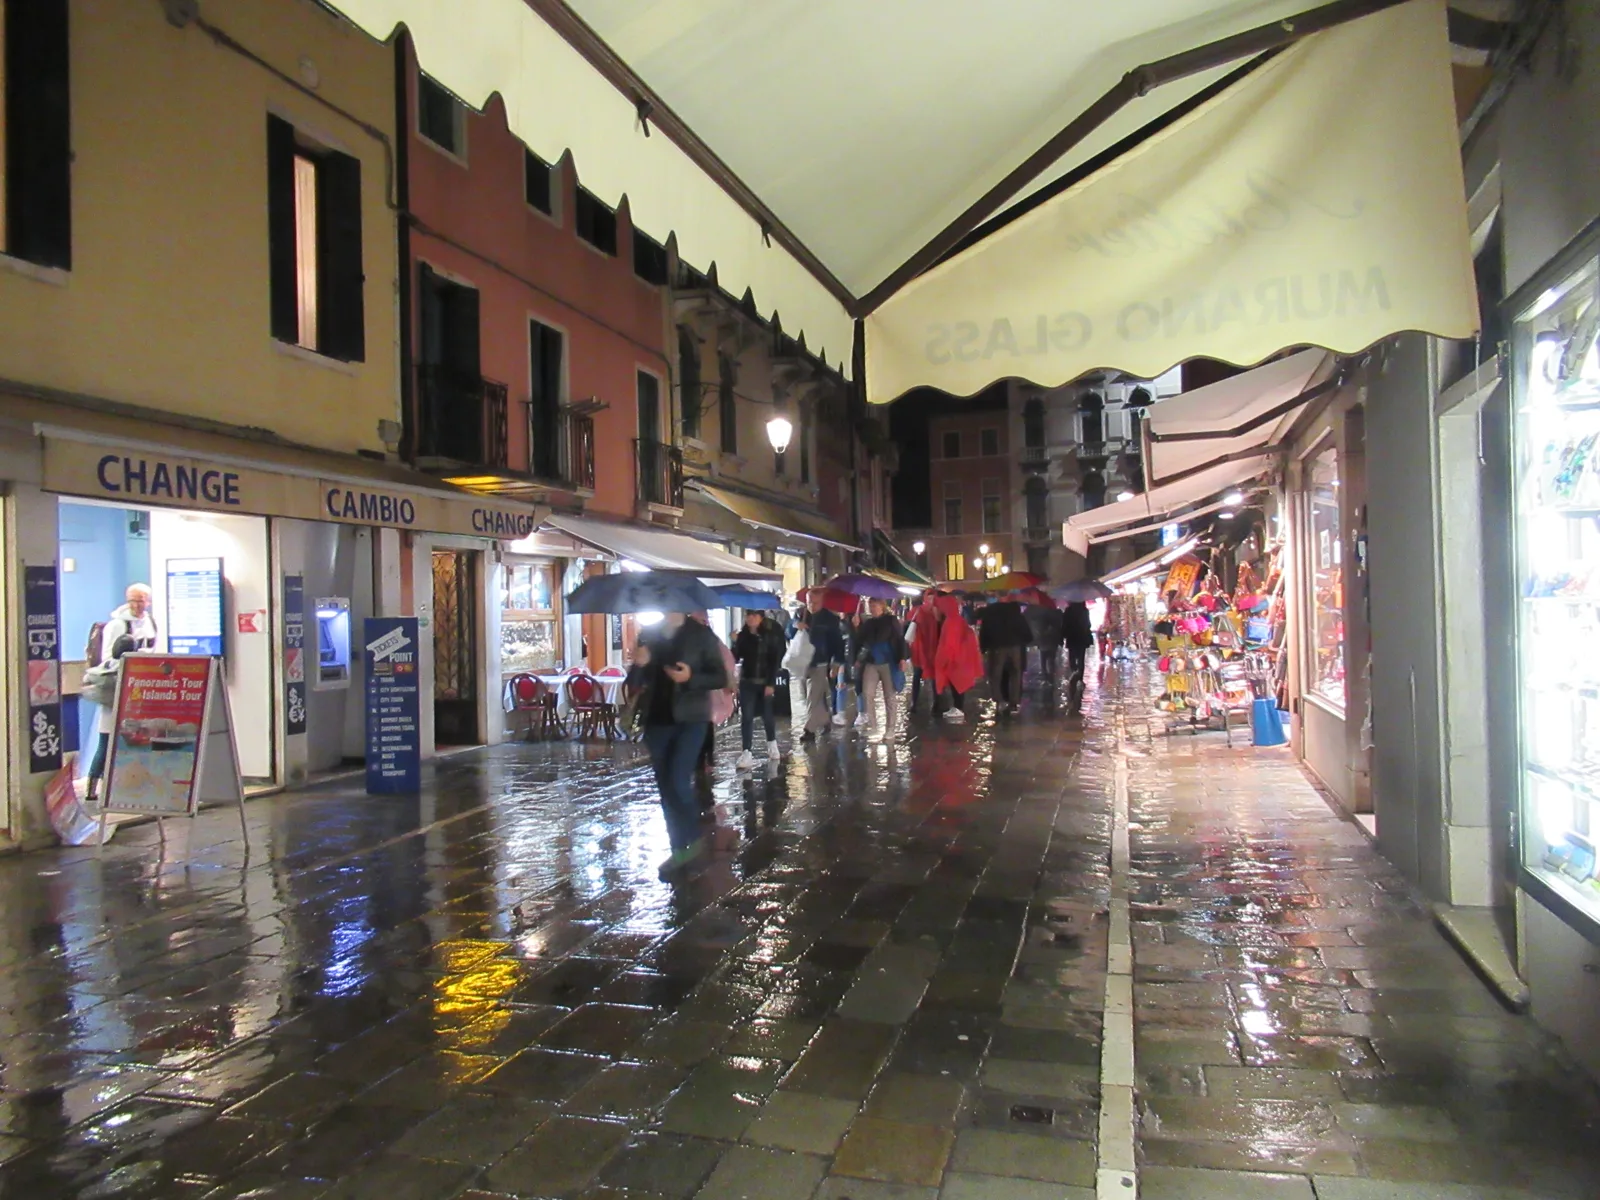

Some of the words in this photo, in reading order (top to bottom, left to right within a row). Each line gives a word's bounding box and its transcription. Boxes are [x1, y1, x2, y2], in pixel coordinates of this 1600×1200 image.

[97, 455, 240, 505] CHANGE
[327, 489, 415, 524] CAMBIO
[28, 614, 56, 625] CHANGE
[389, 652, 413, 663] POINT
[128, 677, 178, 688] Panoramic
[181, 677, 204, 688] Tour
[143, 690, 177, 700] Islands
[180, 690, 202, 701] Tour
